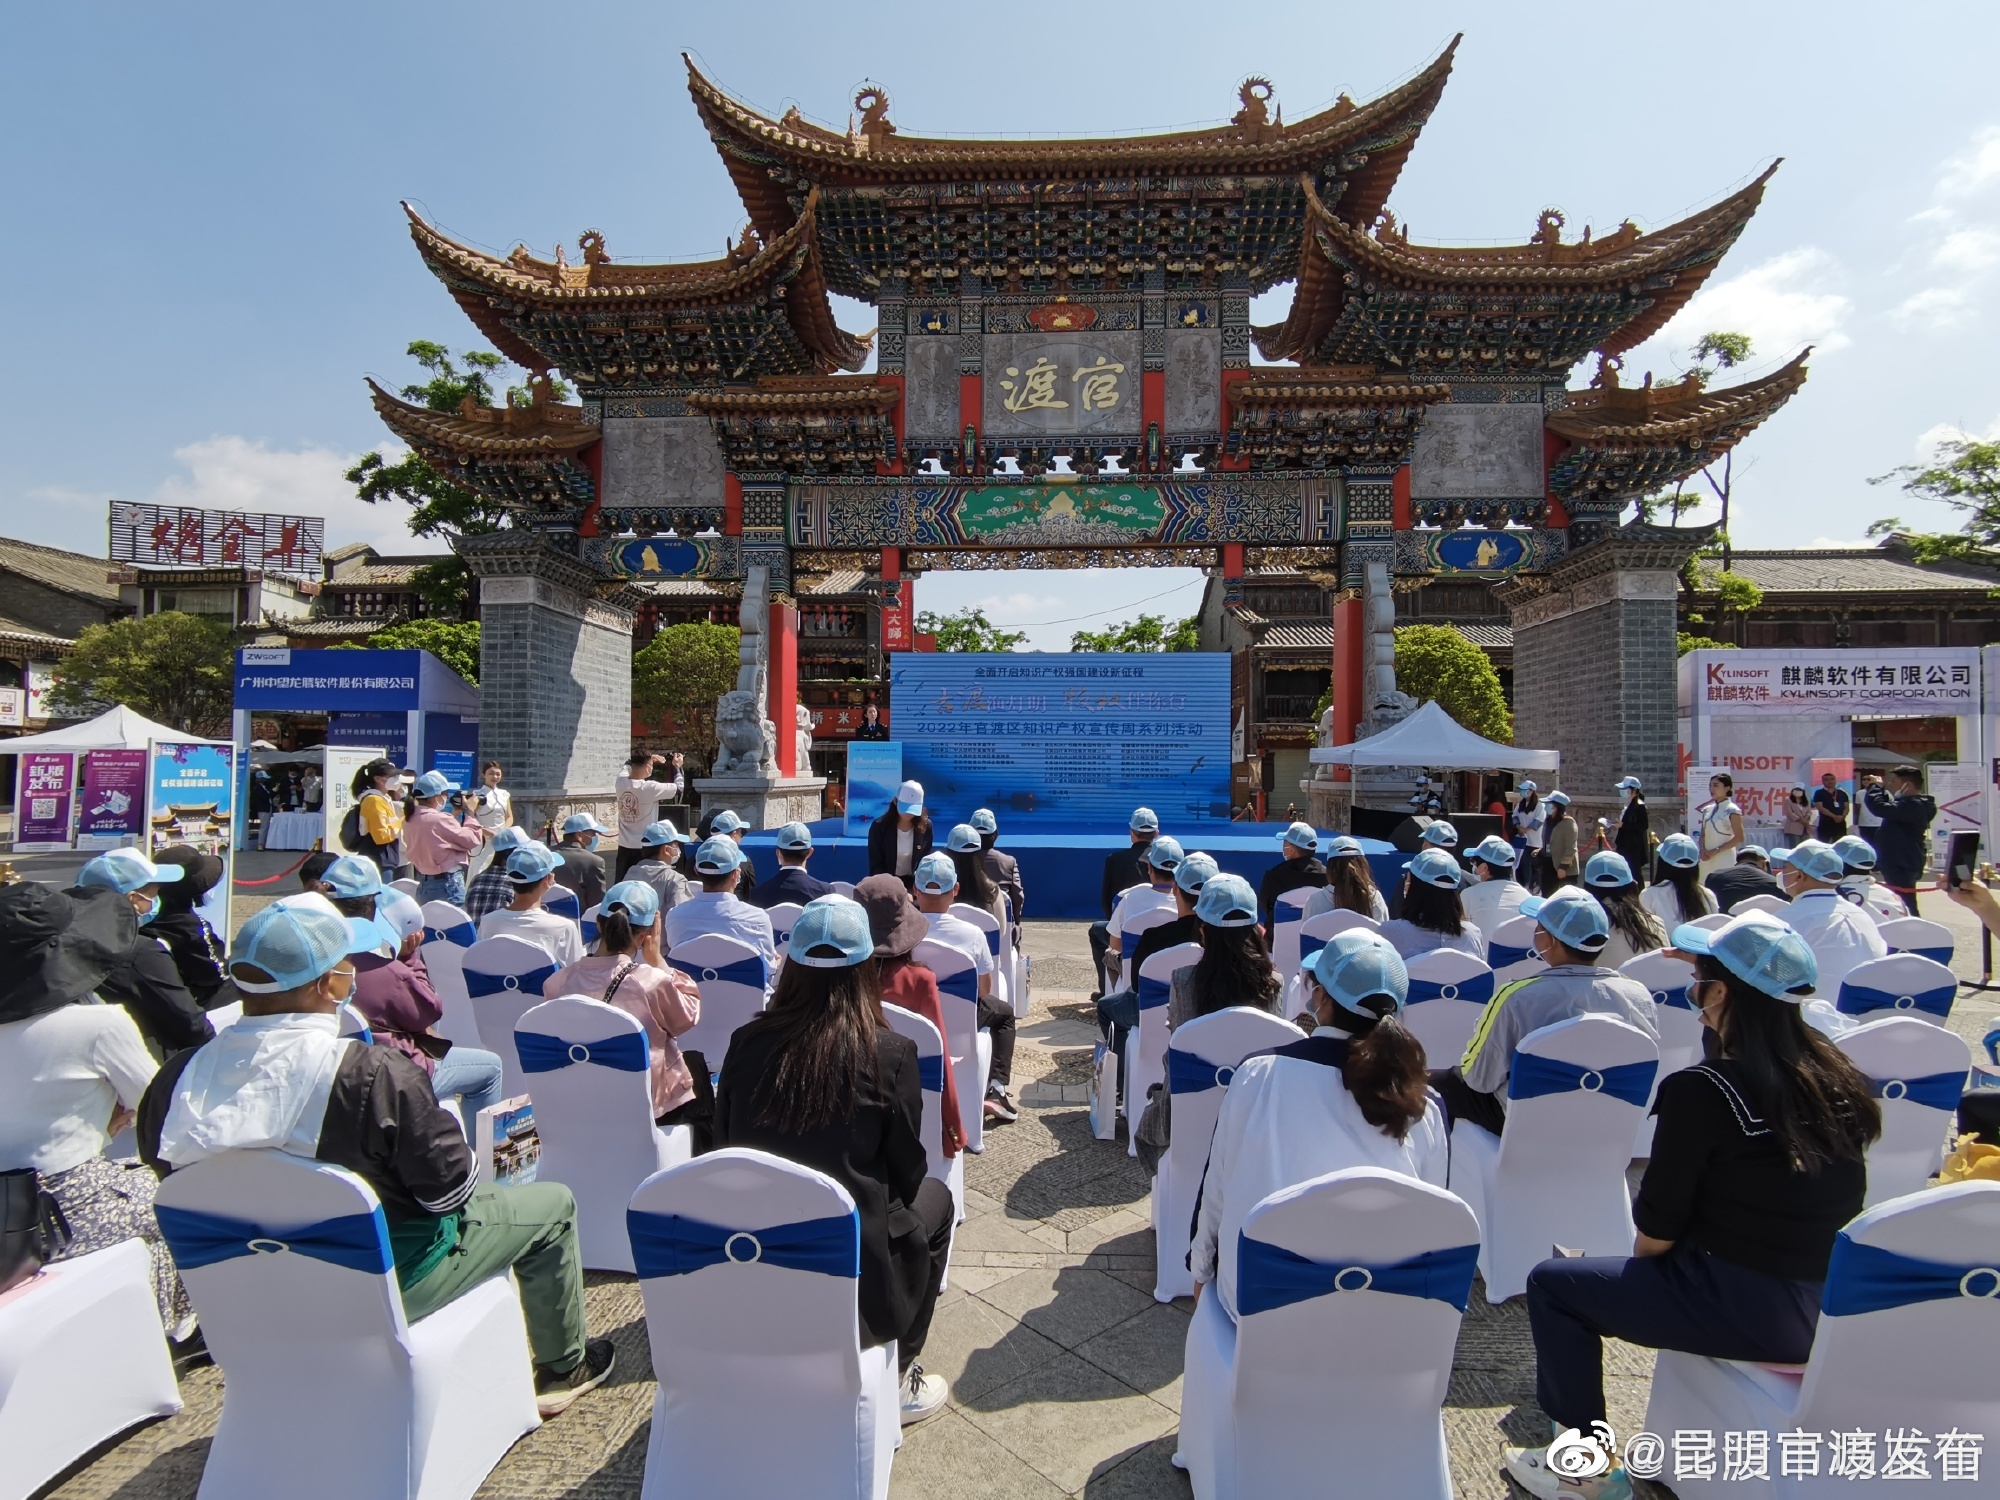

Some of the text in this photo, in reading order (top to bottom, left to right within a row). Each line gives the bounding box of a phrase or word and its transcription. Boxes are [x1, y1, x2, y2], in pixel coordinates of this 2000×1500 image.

[974, 667, 1144, 678] 全面开启知识产权强国建设新征程
[1707, 663, 1769, 685] KYLINSOFT
[1781, 665, 1970, 686] 麒麟软件有限公司
[240, 677, 414, 689] 广州中望龙腾软件股份有限公司
[1707, 686, 1769, 701] 麒麟软件
[1780, 689, 1970, 698] KYLINSOFT CORPORATION
[917, 722, 1203, 736] 2022年官渡区知识产权宣传周系列活动
